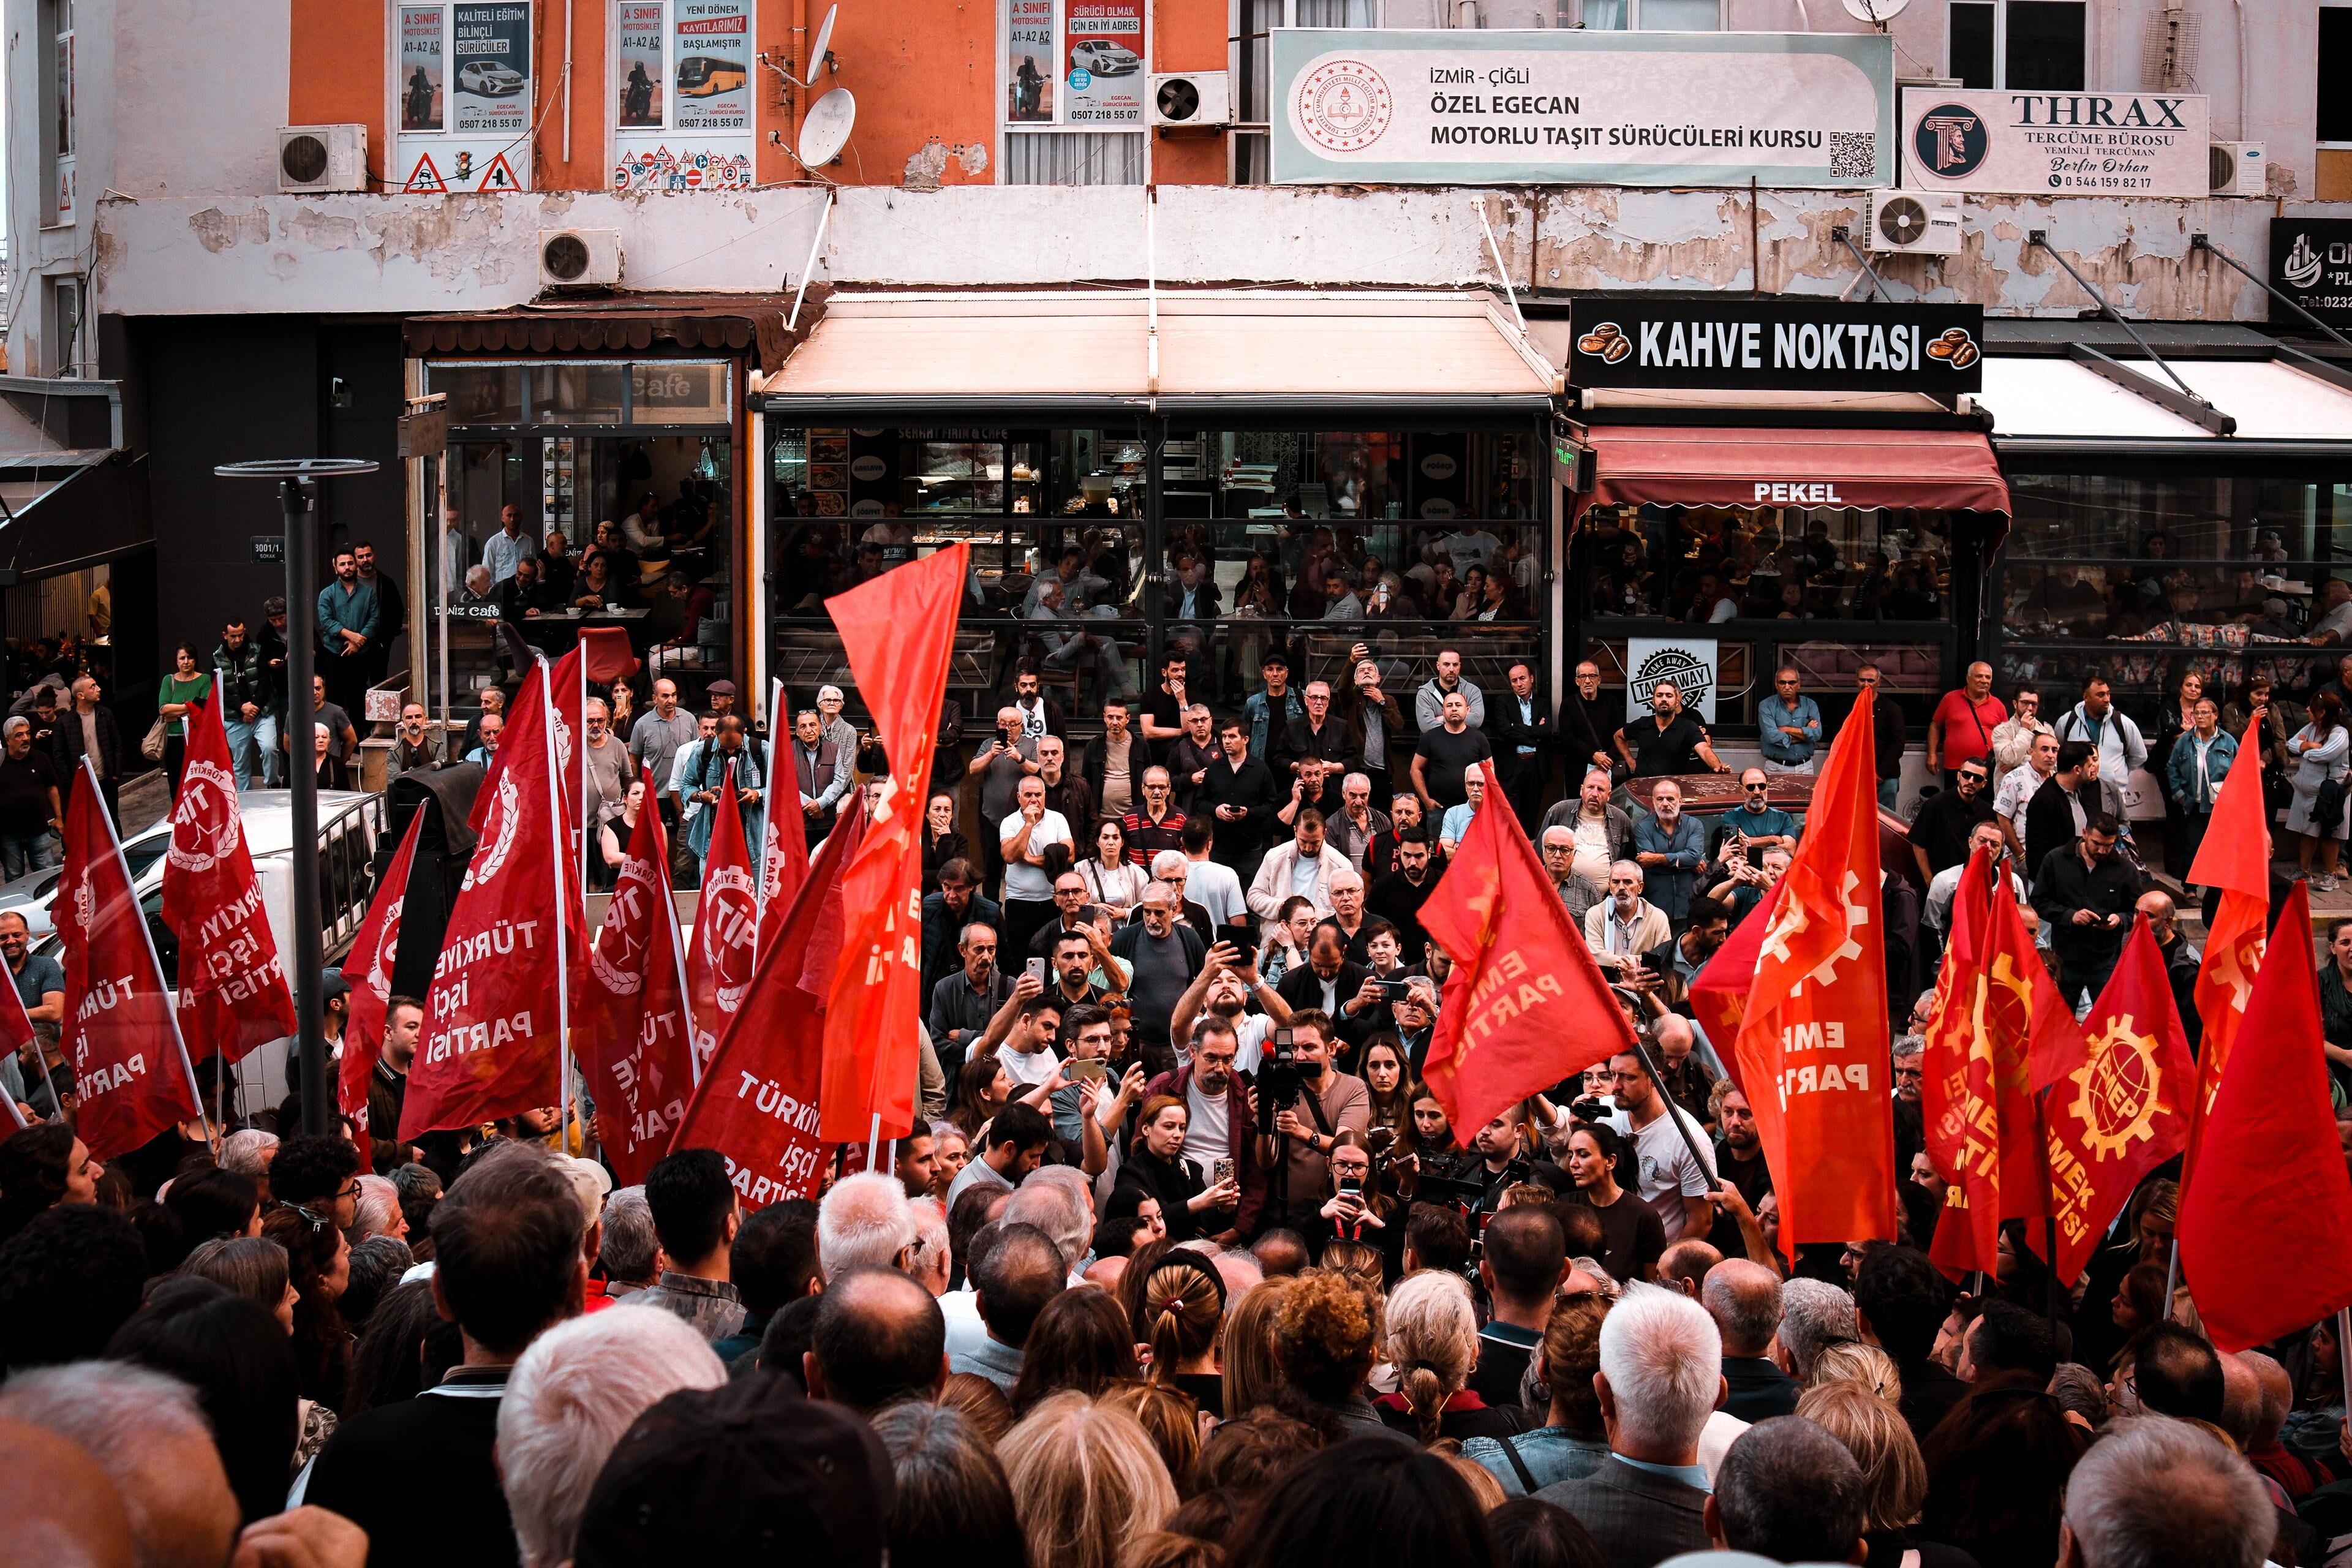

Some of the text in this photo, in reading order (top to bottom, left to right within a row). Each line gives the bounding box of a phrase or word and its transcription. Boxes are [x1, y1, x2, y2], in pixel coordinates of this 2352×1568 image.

[687, 4, 739, 15] YENİ DÖNEM
[1013, 2, 1050, 13] A SINIFI
[1074, 5, 1134, 17] SÜRÜCÜ OLMAK
[405, 13, 440, 24] A SINIFI
[458, 7, 524, 22] KALİTELİ EĞİTİM
[624, 8, 660, 20] A SINIFI
[623, 22, 660, 31] MOTOSİKLET
[683, 17, 742, 32] KAYITLARIMIZ
[1012, 17, 1050, 25] MOTOSİKLET
[1071, 19, 1137, 33] İÇİN EN İYİ ADRES
[404, 28, 440, 36] MOTOSİKLET
[458, 24, 492, 39] BİLİNÇLİ
[1012, 31, 1050, 42] A1-A2 A2
[404, 40, 440, 53] A1-A2 A2
[458, 41, 507, 53] SÜRÜCÜLER
[623, 36, 660, 48] A1-A2 A2
[683, 39, 741, 50] BAŞLAMIŞTIR
[1430, 67, 1475, 84] İZMİR
[1488, 66, 1529, 88] ÇİĞLİ
[1430, 91, 1580, 115] ÖZEL EGECAN
[1071, 110, 1138, 119] 0507 218 55 07
[2011, 95, 2186, 128] THRAX
[459, 119, 522, 129] 0507 218 55 07
[679, 118, 744, 127] 0507 218 55 07
[1430, 124, 1822, 150] MOTORLU TAŞIT SÜRÜCÜLERİ KURSU
[2025, 130, 2175, 146] TERCÜME BÜROSU
[2044, 145, 2155, 156] YEMİNLİ TERCÜMAN
[2050, 156, 2149, 173] Berfin Orhan
[2065, 176, 2151, 187] 0 546 159 82 17
[1640, 321, 1920, 371] KAHVE NOKTASI
[1754, 483, 1842, 503] PEKEL
[434, 604, 465, 616] DNİZ
[1648, 657, 1687, 675] TAKE AWAY
[1681, 692, 1695, 706] WAY
[737, 1069, 821, 1139] TÜRKİY
[778, 1137, 821, 1183] İŞÇİ
[2048, 1125, 2095, 1212] MEK
